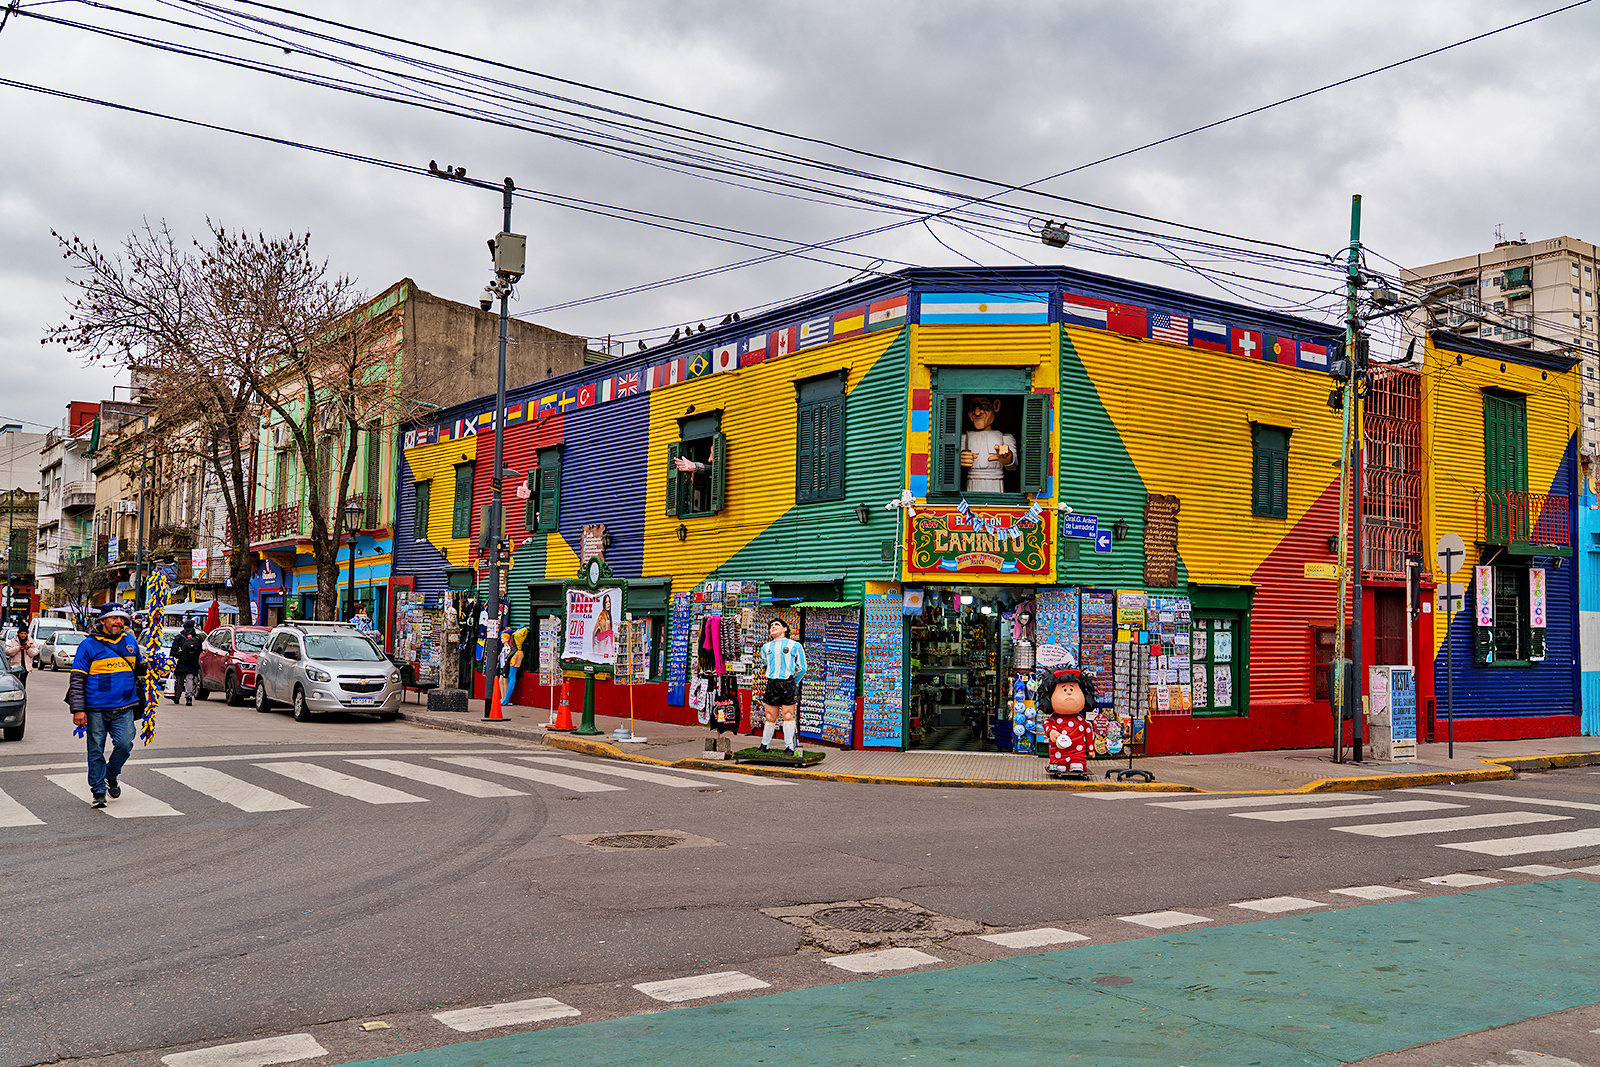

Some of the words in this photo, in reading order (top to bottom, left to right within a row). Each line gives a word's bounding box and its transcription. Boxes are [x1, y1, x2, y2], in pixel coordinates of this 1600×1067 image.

[955, 516, 965, 526] EL
[934, 530, 1025, 553] CAMINITO
[1480, 568, 1490, 625] KIOSCO
[1533, 570, 1543, 625] KIOSCO
[571, 603, 593, 613] PEREZ
[570, 620, 584, 636] 27/8
[1392, 671, 1410, 691] FIESTA
